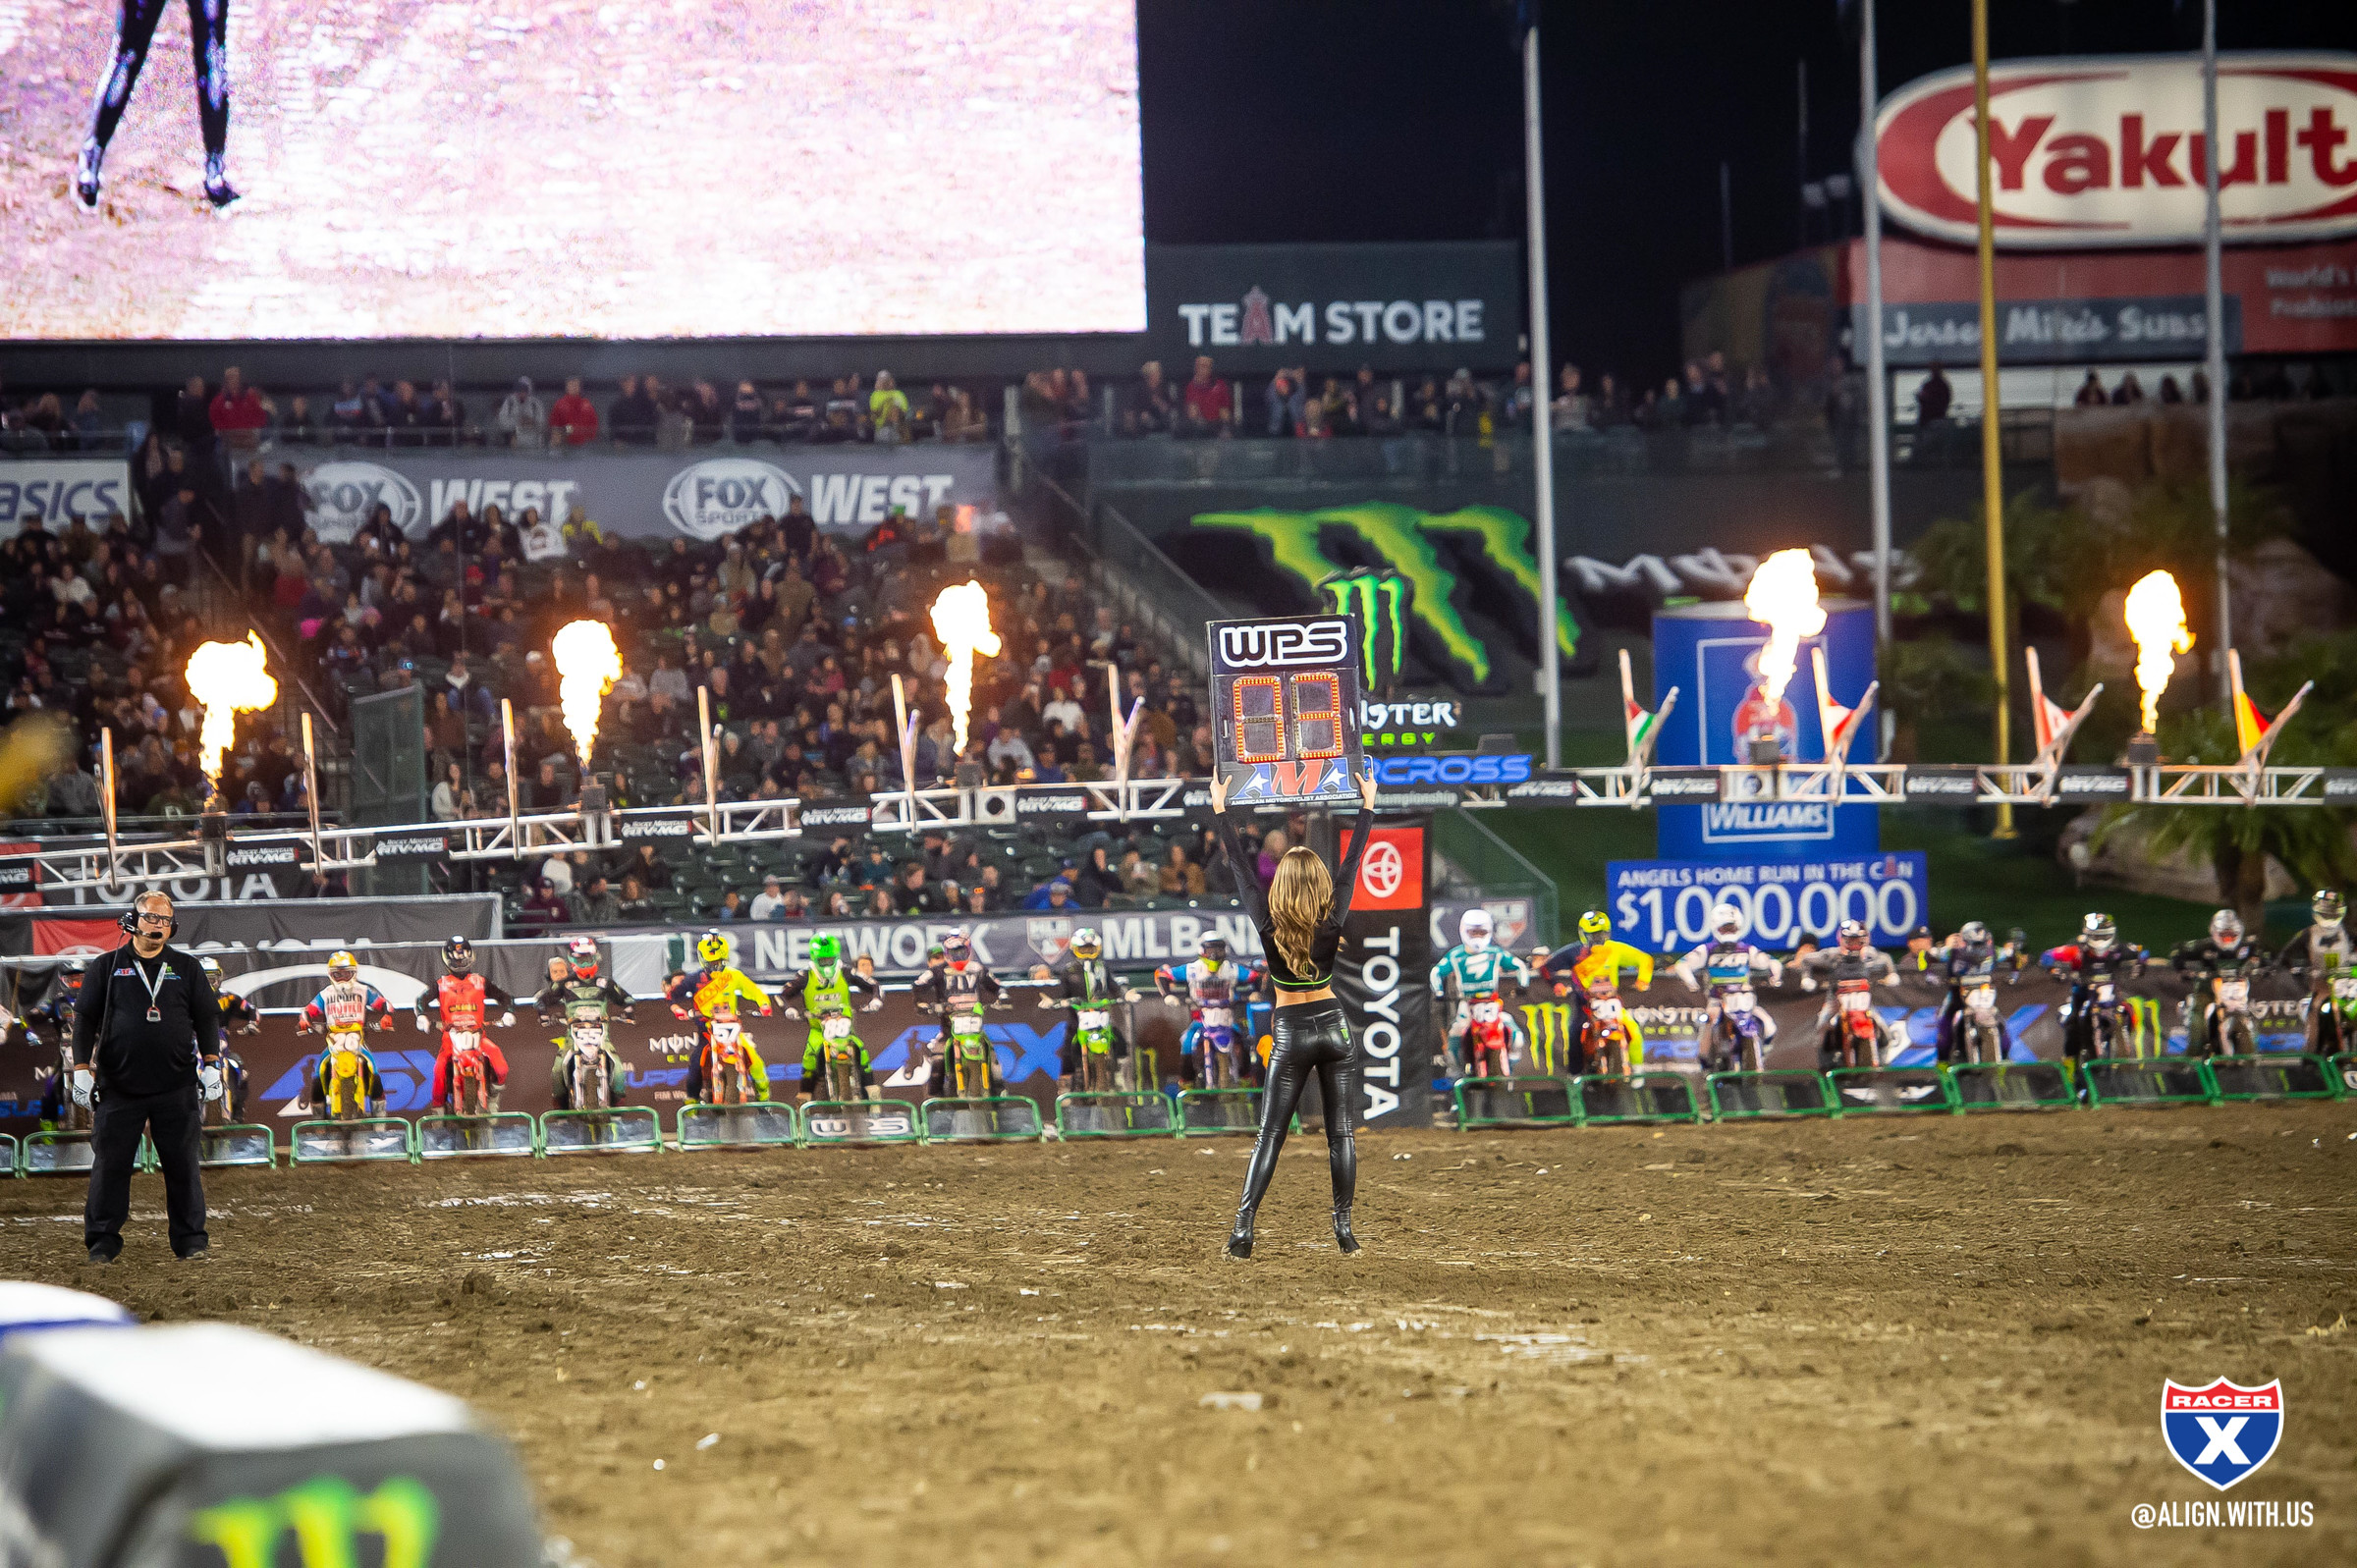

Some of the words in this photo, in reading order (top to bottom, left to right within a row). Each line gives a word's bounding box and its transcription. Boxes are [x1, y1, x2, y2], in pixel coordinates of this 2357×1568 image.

[1968, 106, 2357, 196] Yakult
[1178, 285, 1316, 346] TEAM
[1326, 299, 1486, 344] STORE
[695, 477, 770, 510] FOX
[811, 474, 955, 524] WEST
[1220, 622, 1348, 668] WPS
[1230, 757, 1358, 800] AMA
[1265, 795, 1314, 804] MOTORCYCLIST
[1315, 792, 1357, 801] ASSOCIATION
[1709, 801, 1829, 830] WILLIAMS
[1617, 868, 1692, 887] ANGELS
[1695, 866, 1755, 885] HOME
[1758, 864, 1800, 883] RUN
[1803, 863, 1826, 882] IN
[1829, 862, 1865, 881] THE
[1869, 856, 1913, 881] CAN
[1102, 914, 1202, 960] MLB
[1616, 879, 1918, 951] $1,000,000
[712, 1023, 741, 1044] 57
[1361, 925, 1402, 1120] TOYOTA
